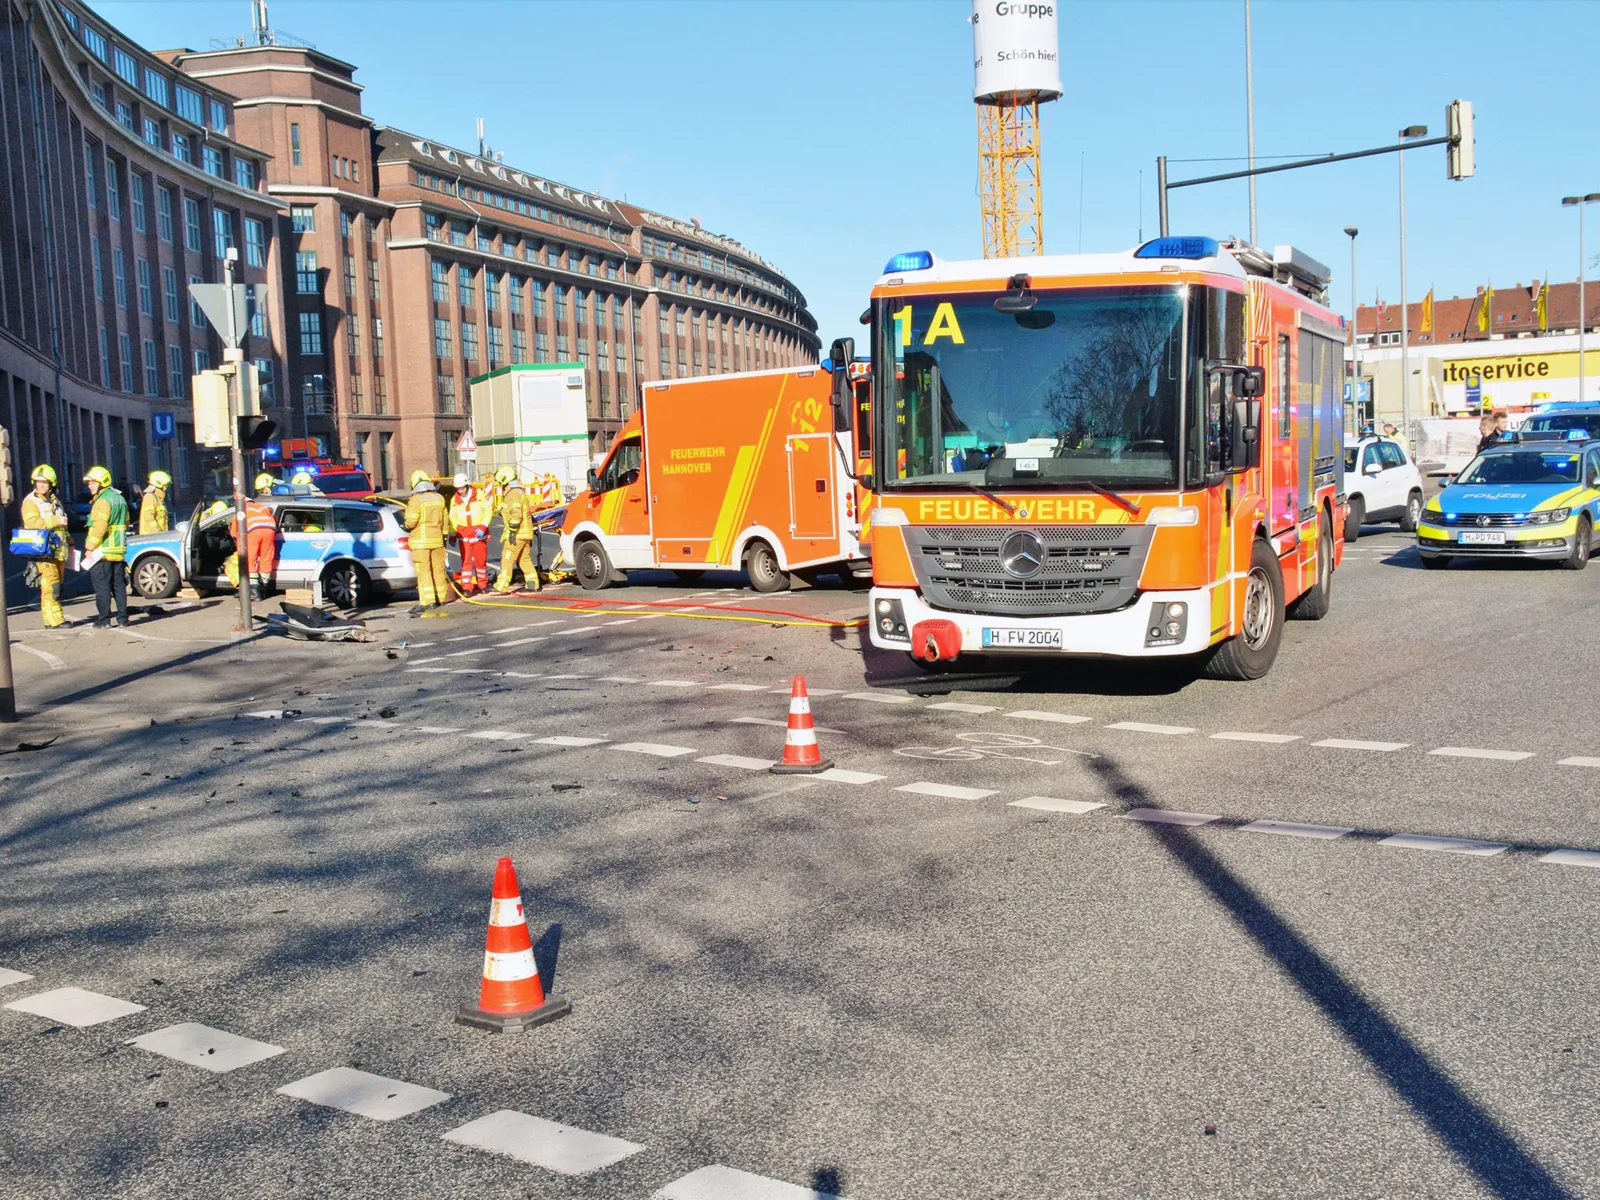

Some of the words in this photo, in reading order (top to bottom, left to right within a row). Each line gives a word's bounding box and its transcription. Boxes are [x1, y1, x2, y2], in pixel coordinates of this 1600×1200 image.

[996, 1, 1053, 19] Gruppe
[997, 49, 1035, 62] Schön
[1038, 50, 1057, 62] hier!
[1482, 396, 1490, 407] 2
[155, 415, 171, 435] U
[670, 446, 725, 459] FEUERWEHR
[663, 463, 711, 474] HANNOVER
[1029, 631, 1060, 644] 2004
